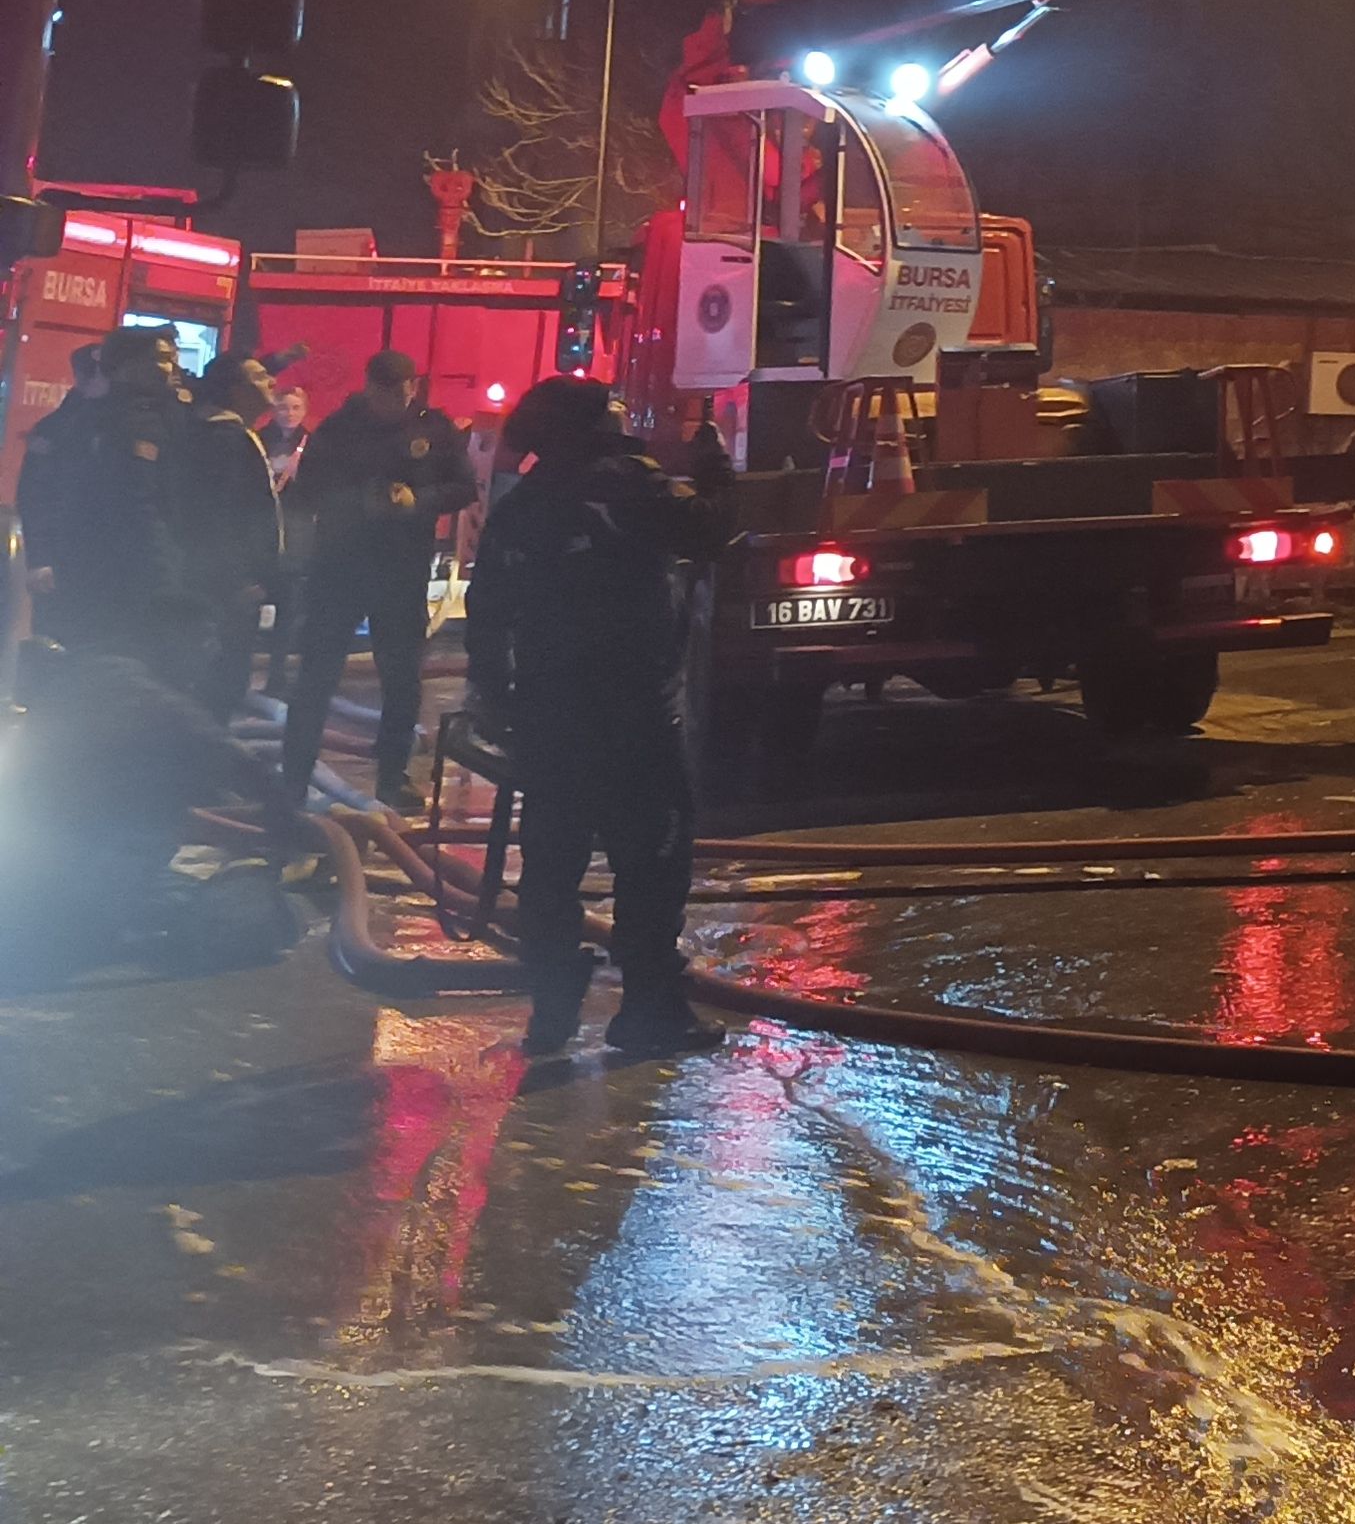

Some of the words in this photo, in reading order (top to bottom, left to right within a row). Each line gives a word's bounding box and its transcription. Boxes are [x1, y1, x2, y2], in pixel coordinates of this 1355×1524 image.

[43, 270, 108, 309] BURSA
[898, 264, 972, 289] BURSA
[767, 600, 792, 624] 16
[797, 598, 842, 622] BAV
[847, 597, 887, 620] 731
